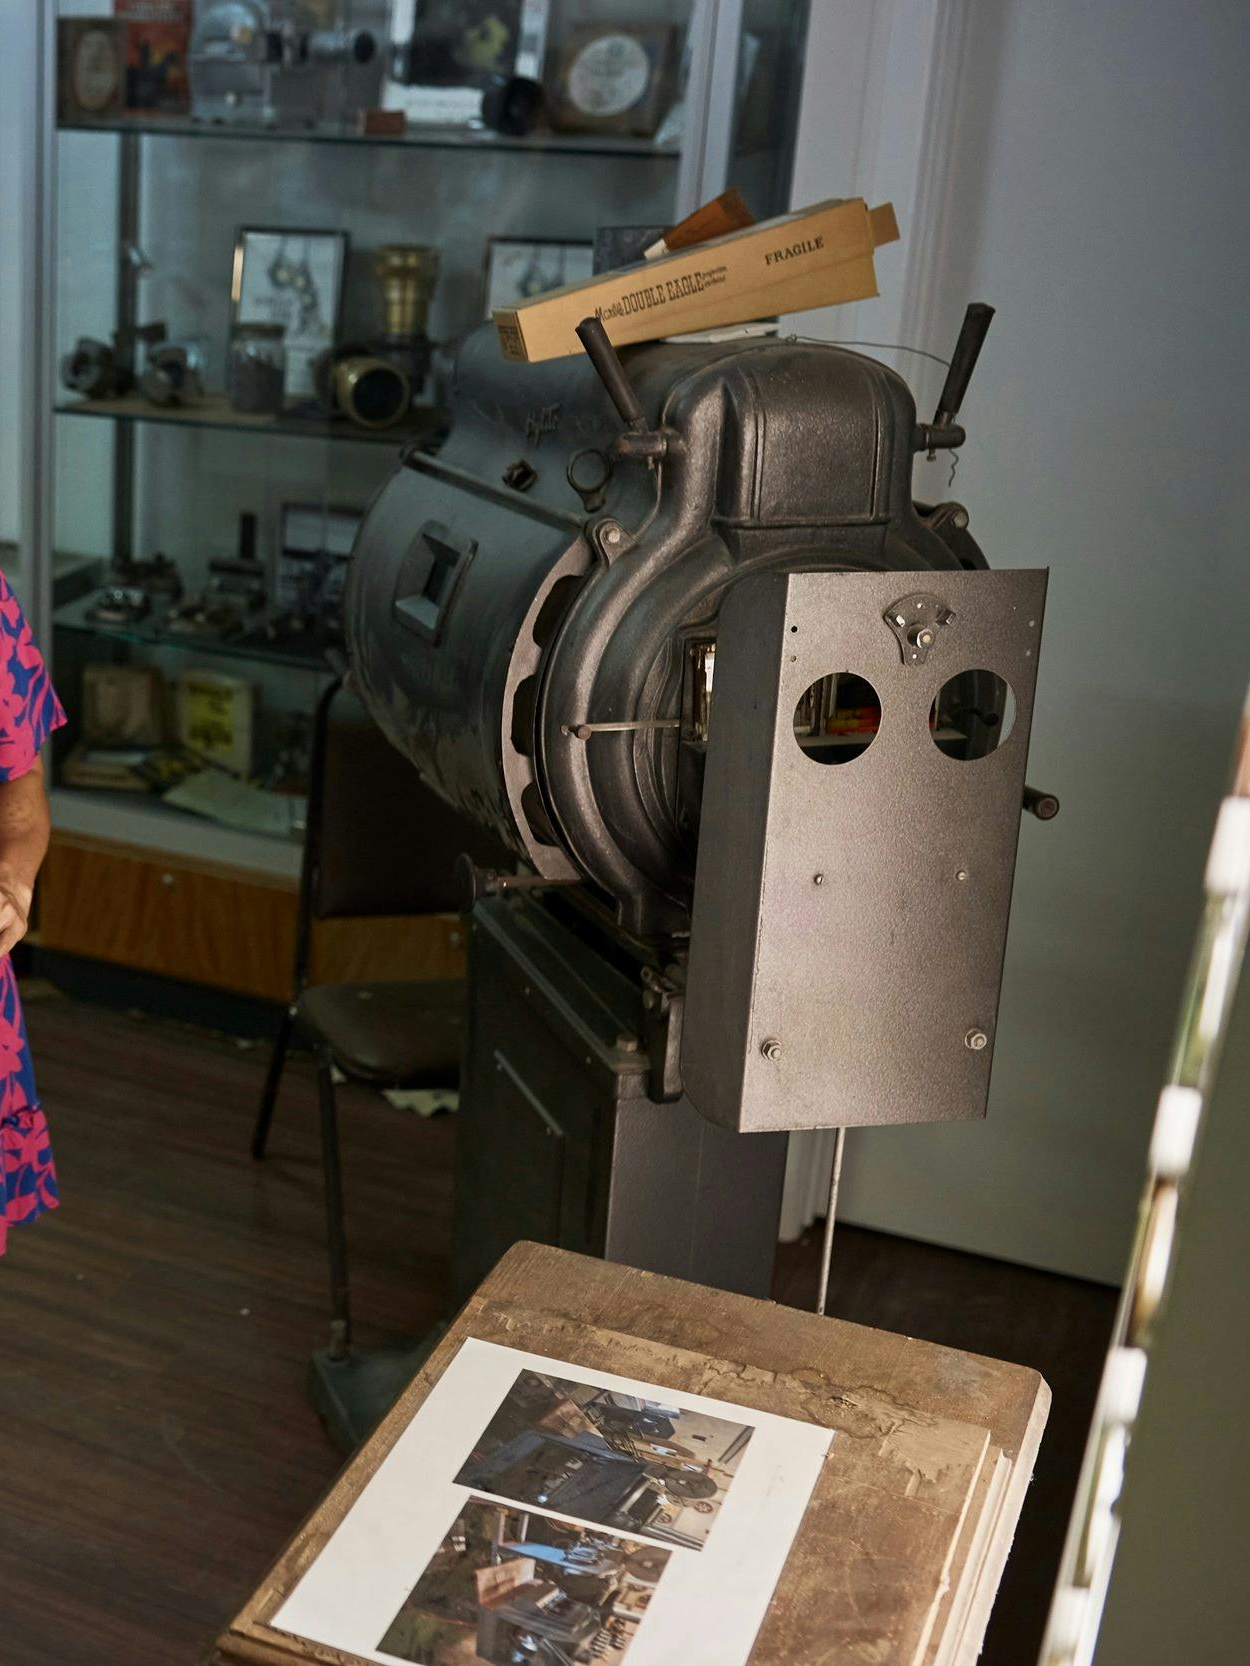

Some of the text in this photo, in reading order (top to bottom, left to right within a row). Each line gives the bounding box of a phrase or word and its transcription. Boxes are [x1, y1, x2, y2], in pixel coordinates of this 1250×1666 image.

[764, 236, 825, 266] FRAGILE
[621, 286, 666, 315] DOUBLE
[666, 271, 704, 301] EAGLE
